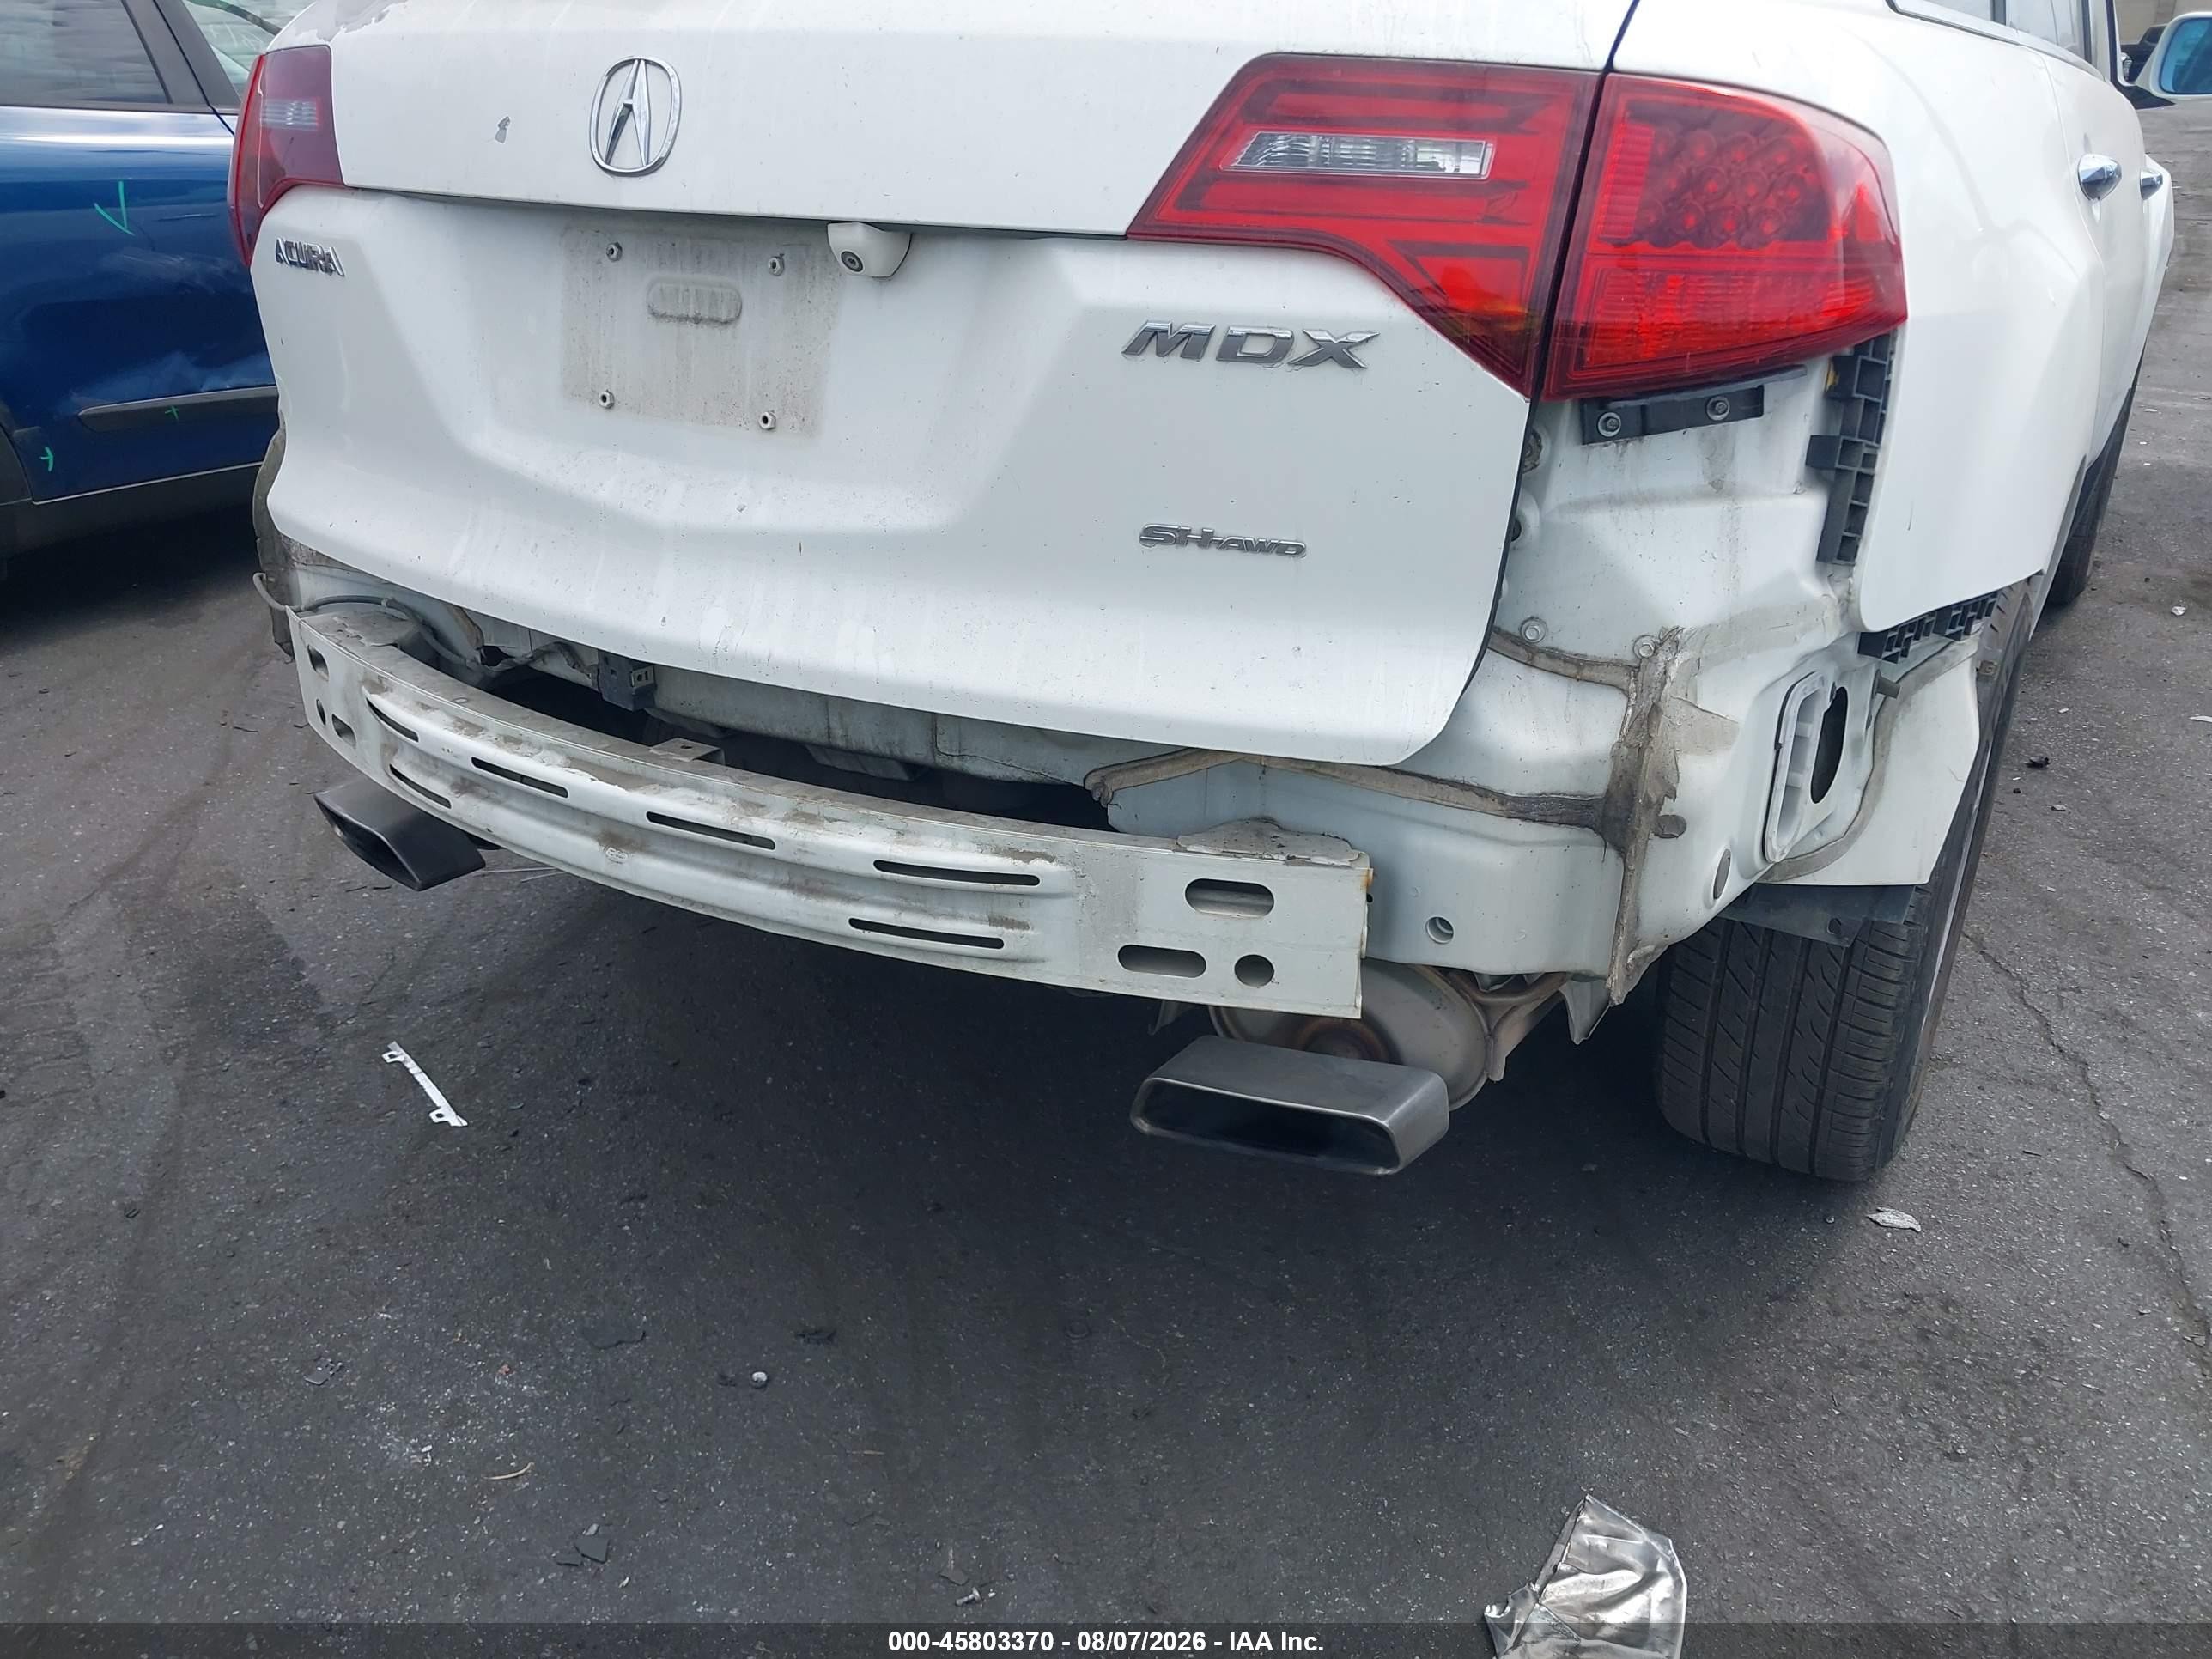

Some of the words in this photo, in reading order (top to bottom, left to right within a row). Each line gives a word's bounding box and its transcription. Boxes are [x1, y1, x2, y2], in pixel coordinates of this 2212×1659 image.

[275, 237, 345, 276] ACURA
[1121, 319, 1381, 369] MDX
[1139, 523, 1307, 558] SH-AWD
